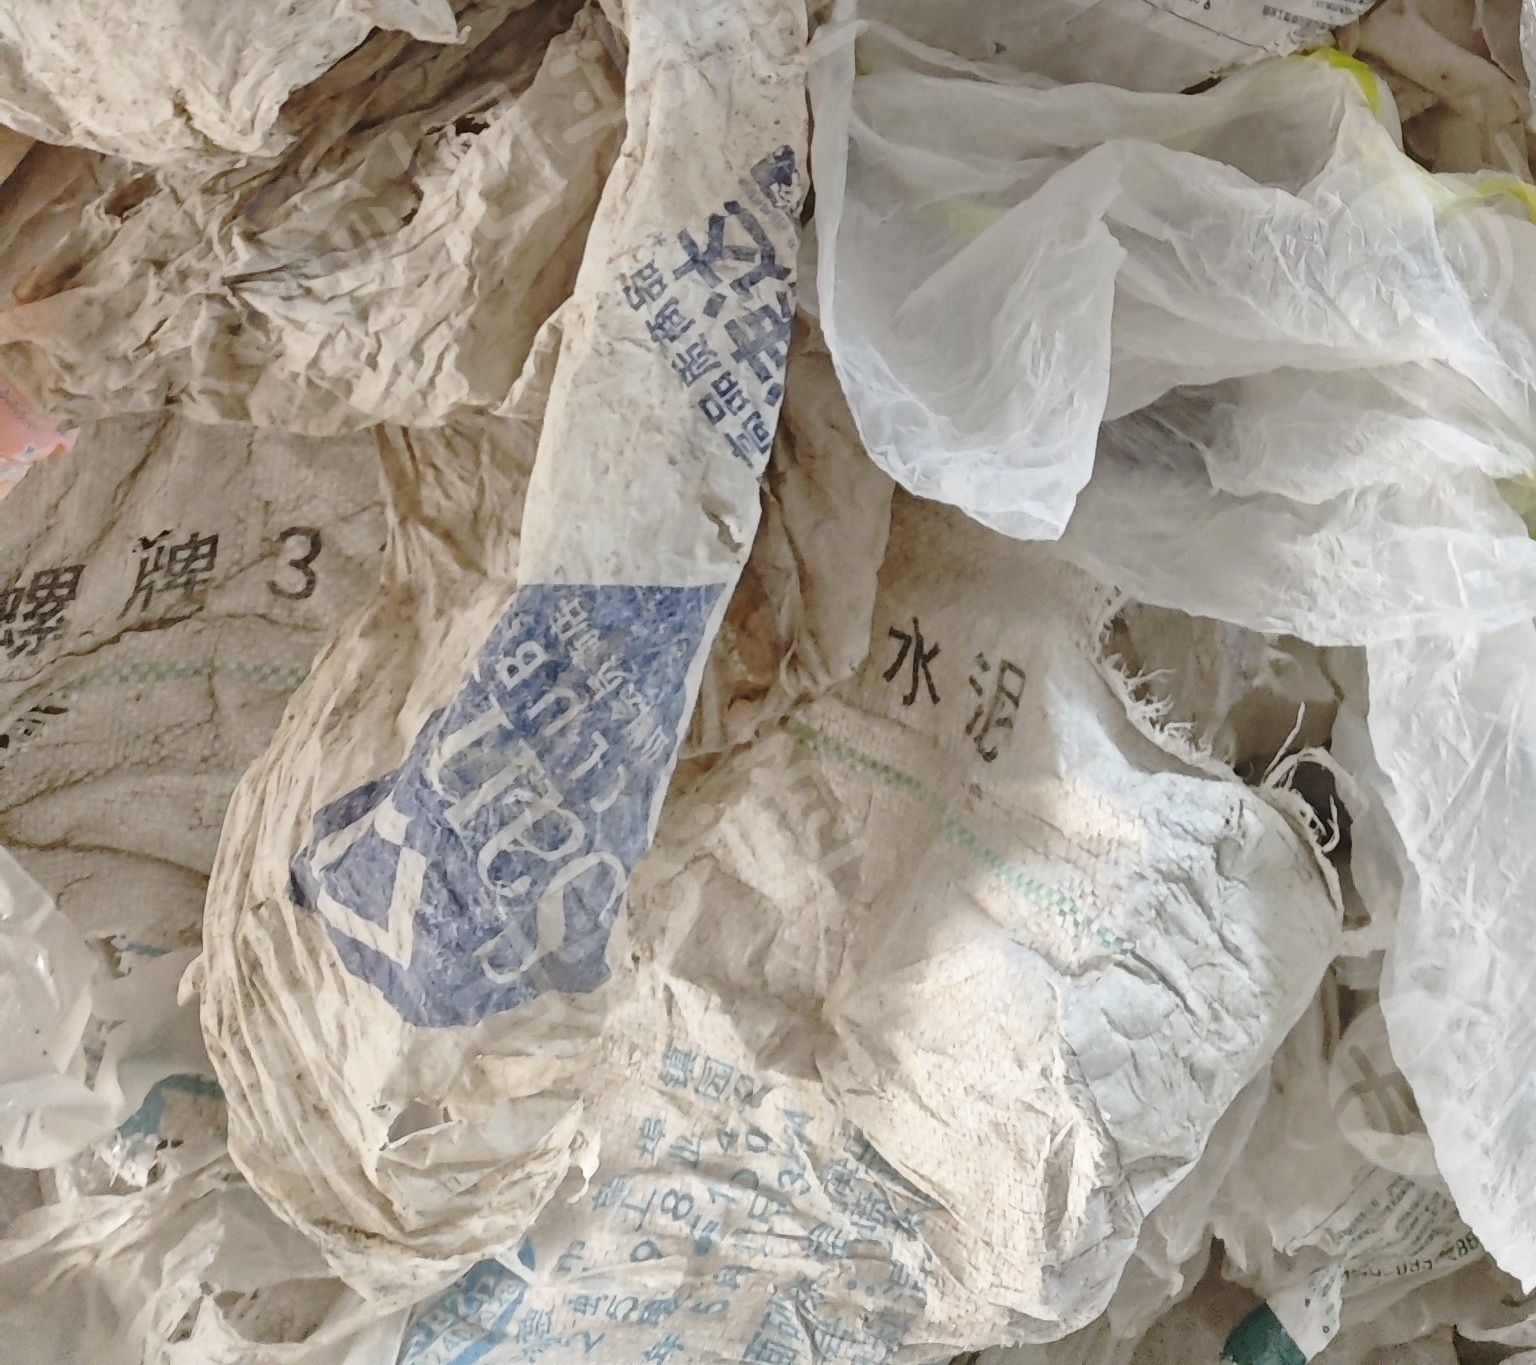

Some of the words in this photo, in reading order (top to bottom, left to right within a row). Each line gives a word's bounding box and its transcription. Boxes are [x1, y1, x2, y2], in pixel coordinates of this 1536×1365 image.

[622, 260, 773, 468] 高品质商品
